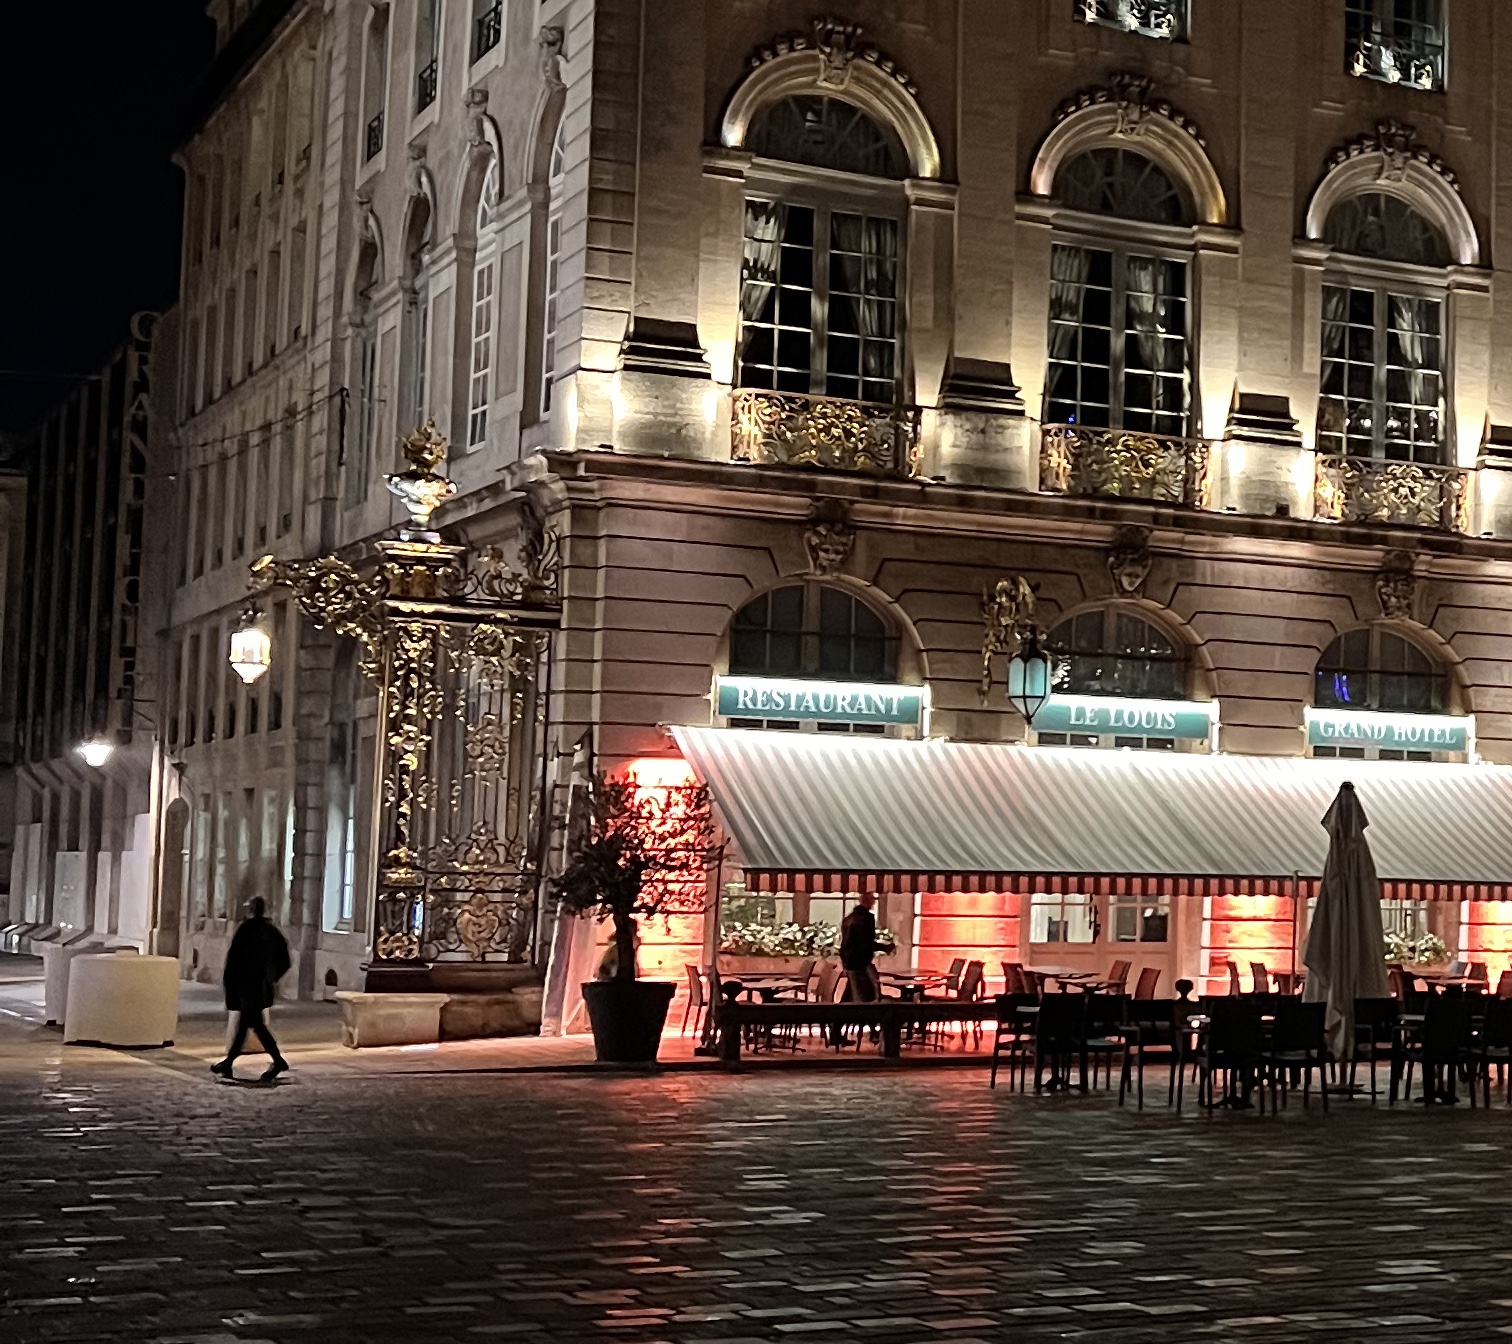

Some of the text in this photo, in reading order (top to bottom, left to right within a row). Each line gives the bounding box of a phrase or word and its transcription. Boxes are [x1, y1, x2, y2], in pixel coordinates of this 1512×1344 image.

[737, 687, 904, 716] RESTAURANT
[1069, 705, 1177, 730] LE LOUIS
[1319, 720, 1457, 744] GRAND HOTEL
